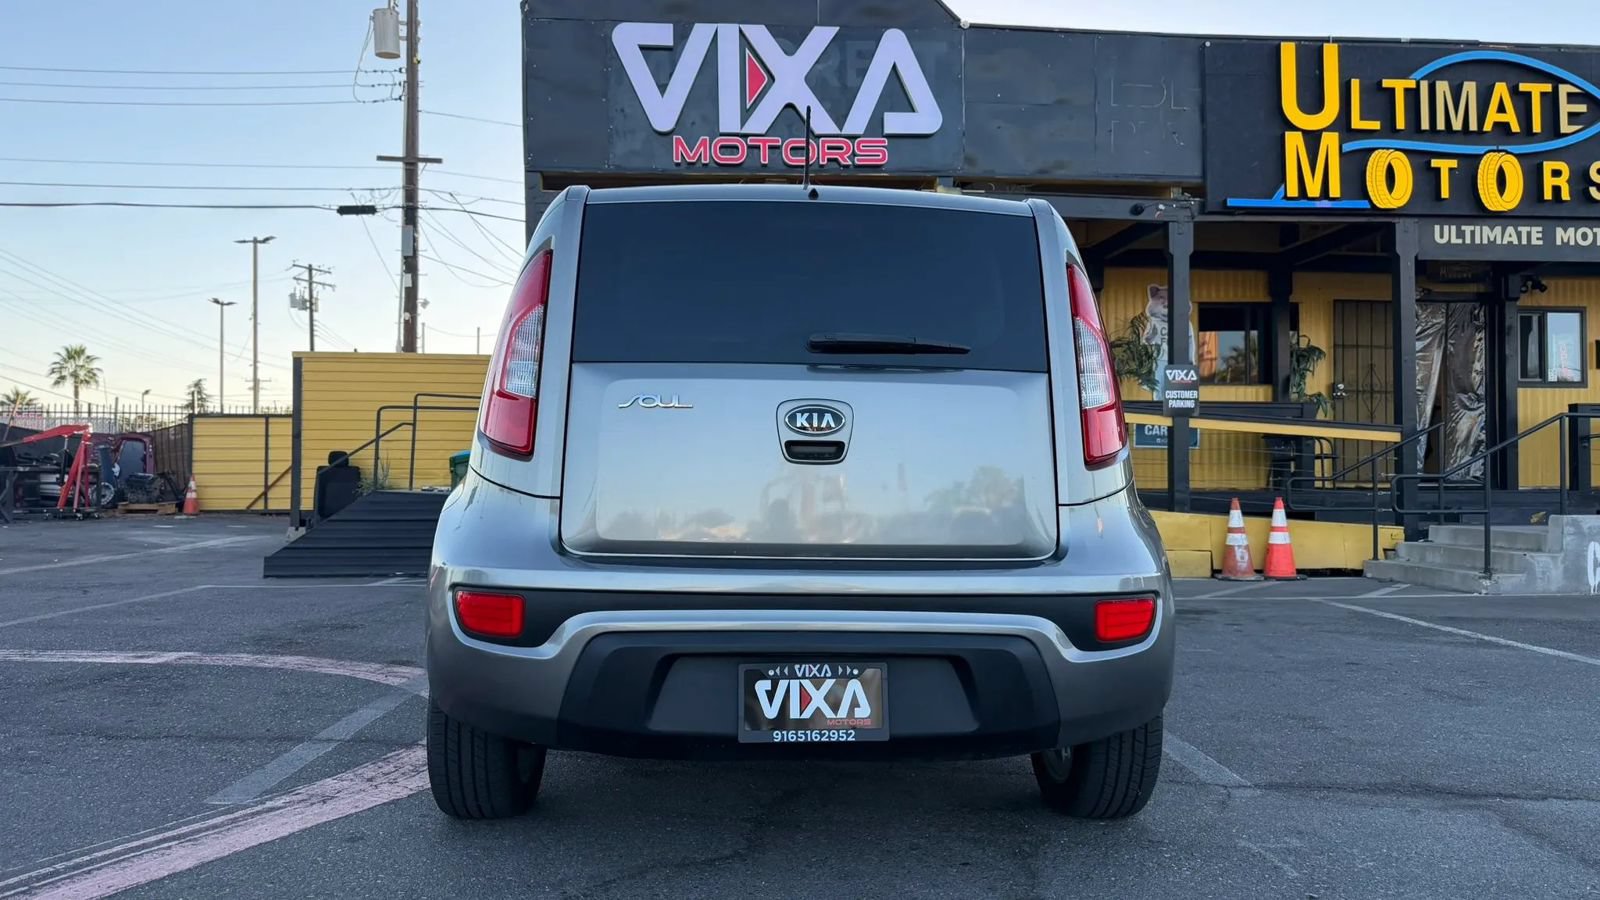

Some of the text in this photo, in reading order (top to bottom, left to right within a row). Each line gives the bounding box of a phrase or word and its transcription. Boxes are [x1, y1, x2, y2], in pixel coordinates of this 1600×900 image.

[612, 22, 943, 135] VIXA
[1280, 41, 1588, 134] ULTIMATE
[672, 136, 888, 165] MOTORS
[1434, 224, 1544, 245] ULTIMATE
[1165, 369, 1197, 381] VIXA
[618, 394, 694, 409] SOUL
[1165, 390, 1198, 399] CUSTOMER
[1168, 400, 1195, 409] PARKING
[796, 412, 836, 428] KIA
[794, 664, 832, 677] VIXA
[754, 679, 871, 719] VIXA
[773, 730, 856, 742] 9165162952
